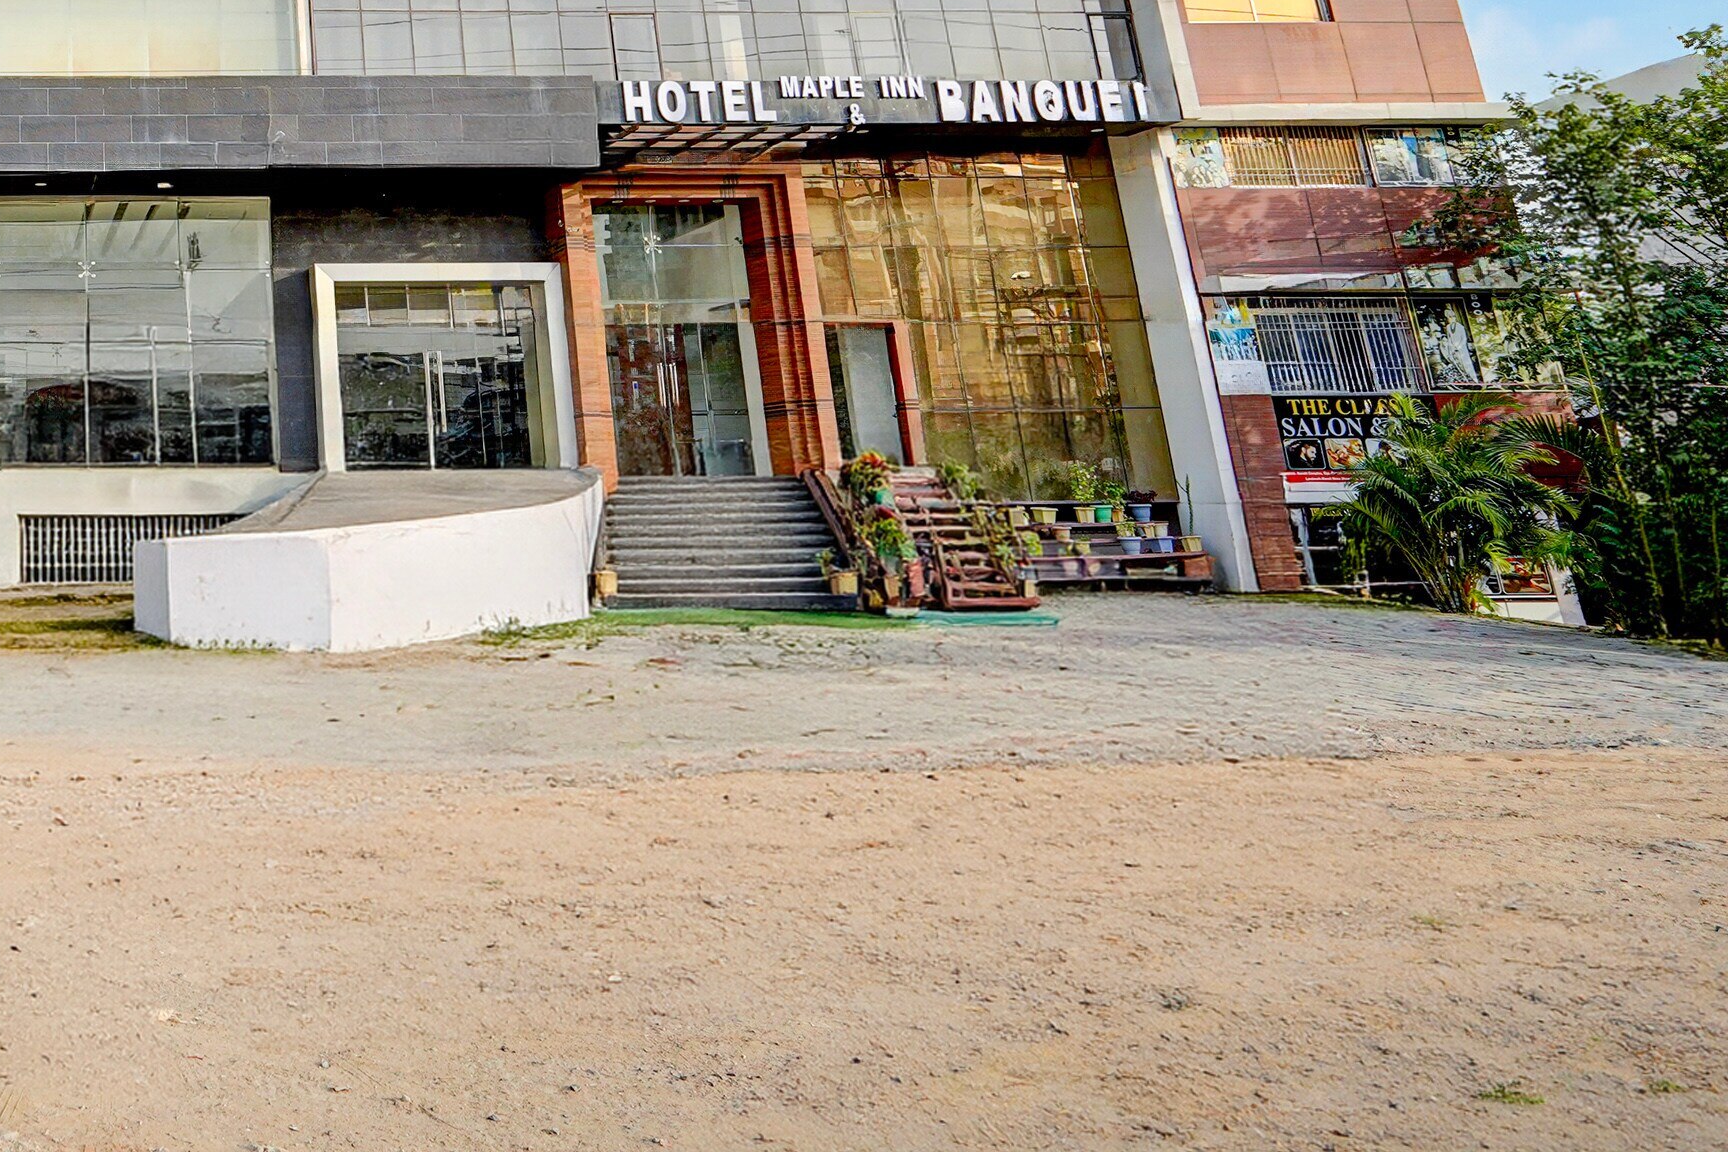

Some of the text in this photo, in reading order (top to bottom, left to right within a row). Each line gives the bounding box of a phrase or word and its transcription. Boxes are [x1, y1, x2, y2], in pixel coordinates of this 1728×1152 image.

[778, 75, 925, 98] MAPLE INN
[621, 79, 777, 123] HOTEL
[849, 102, 866, 125] &
[1286, 398, 1332, 416] THE
[1281, 417, 1364, 437] SALON
